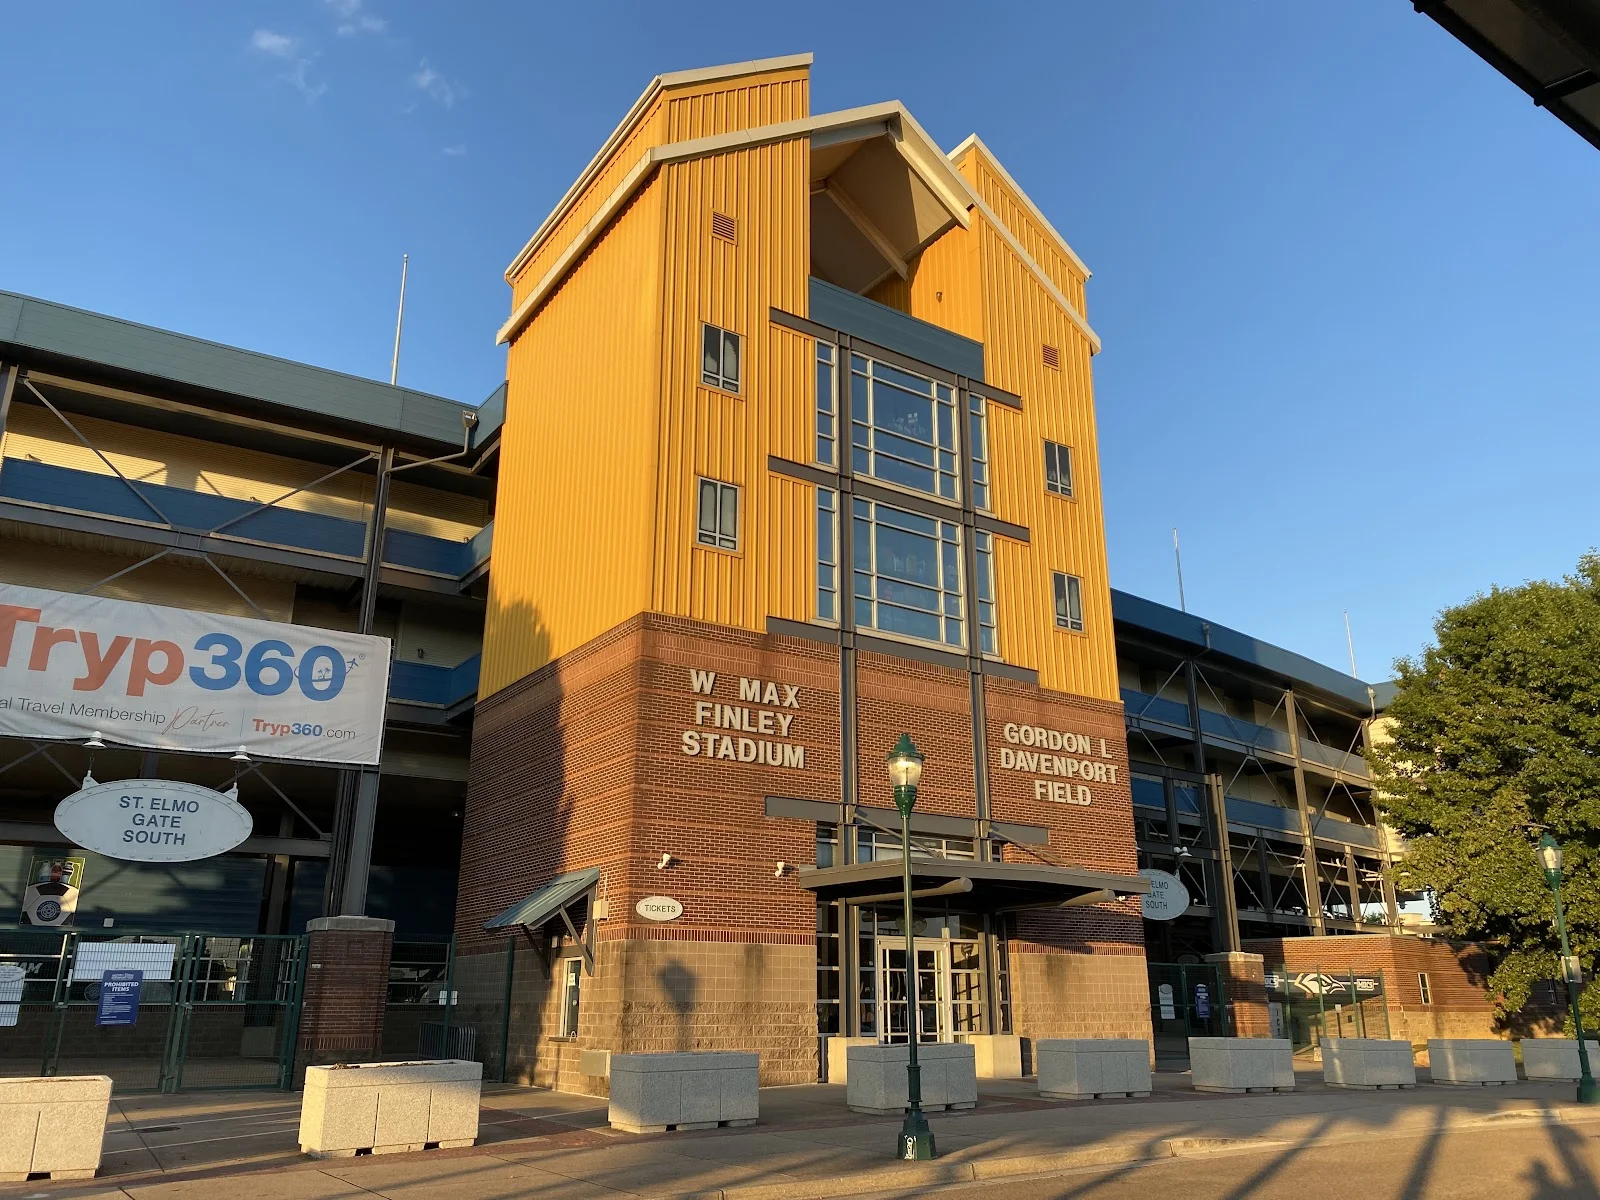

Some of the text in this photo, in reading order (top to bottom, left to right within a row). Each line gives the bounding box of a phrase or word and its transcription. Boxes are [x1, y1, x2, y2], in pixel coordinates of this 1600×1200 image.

[0, 604, 346, 701] Tryp360
[690, 669, 800, 709] W MAX
[0, 697, 230, 735] al Travel Membership Partner
[696, 701, 794, 737] FINLEY
[253, 719, 356, 740] Tryp360.com
[1003, 722, 1113, 759] GORDON L
[682, 730, 805, 769] STADIUM
[1000, 747, 1119, 784] DAVENPORT
[119, 795, 200, 813] ST. ELMO
[1035, 780, 1092, 806] FIELD
[132, 813, 182, 828] GATE
[122, 829, 186, 846] SOUTH
[1151, 880, 1169, 890] ELMO
[645, 904, 676, 913] TICKETS
[1145, 900, 1168, 910] SOUTH
[1357, 980, 1373, 988] MOCS
